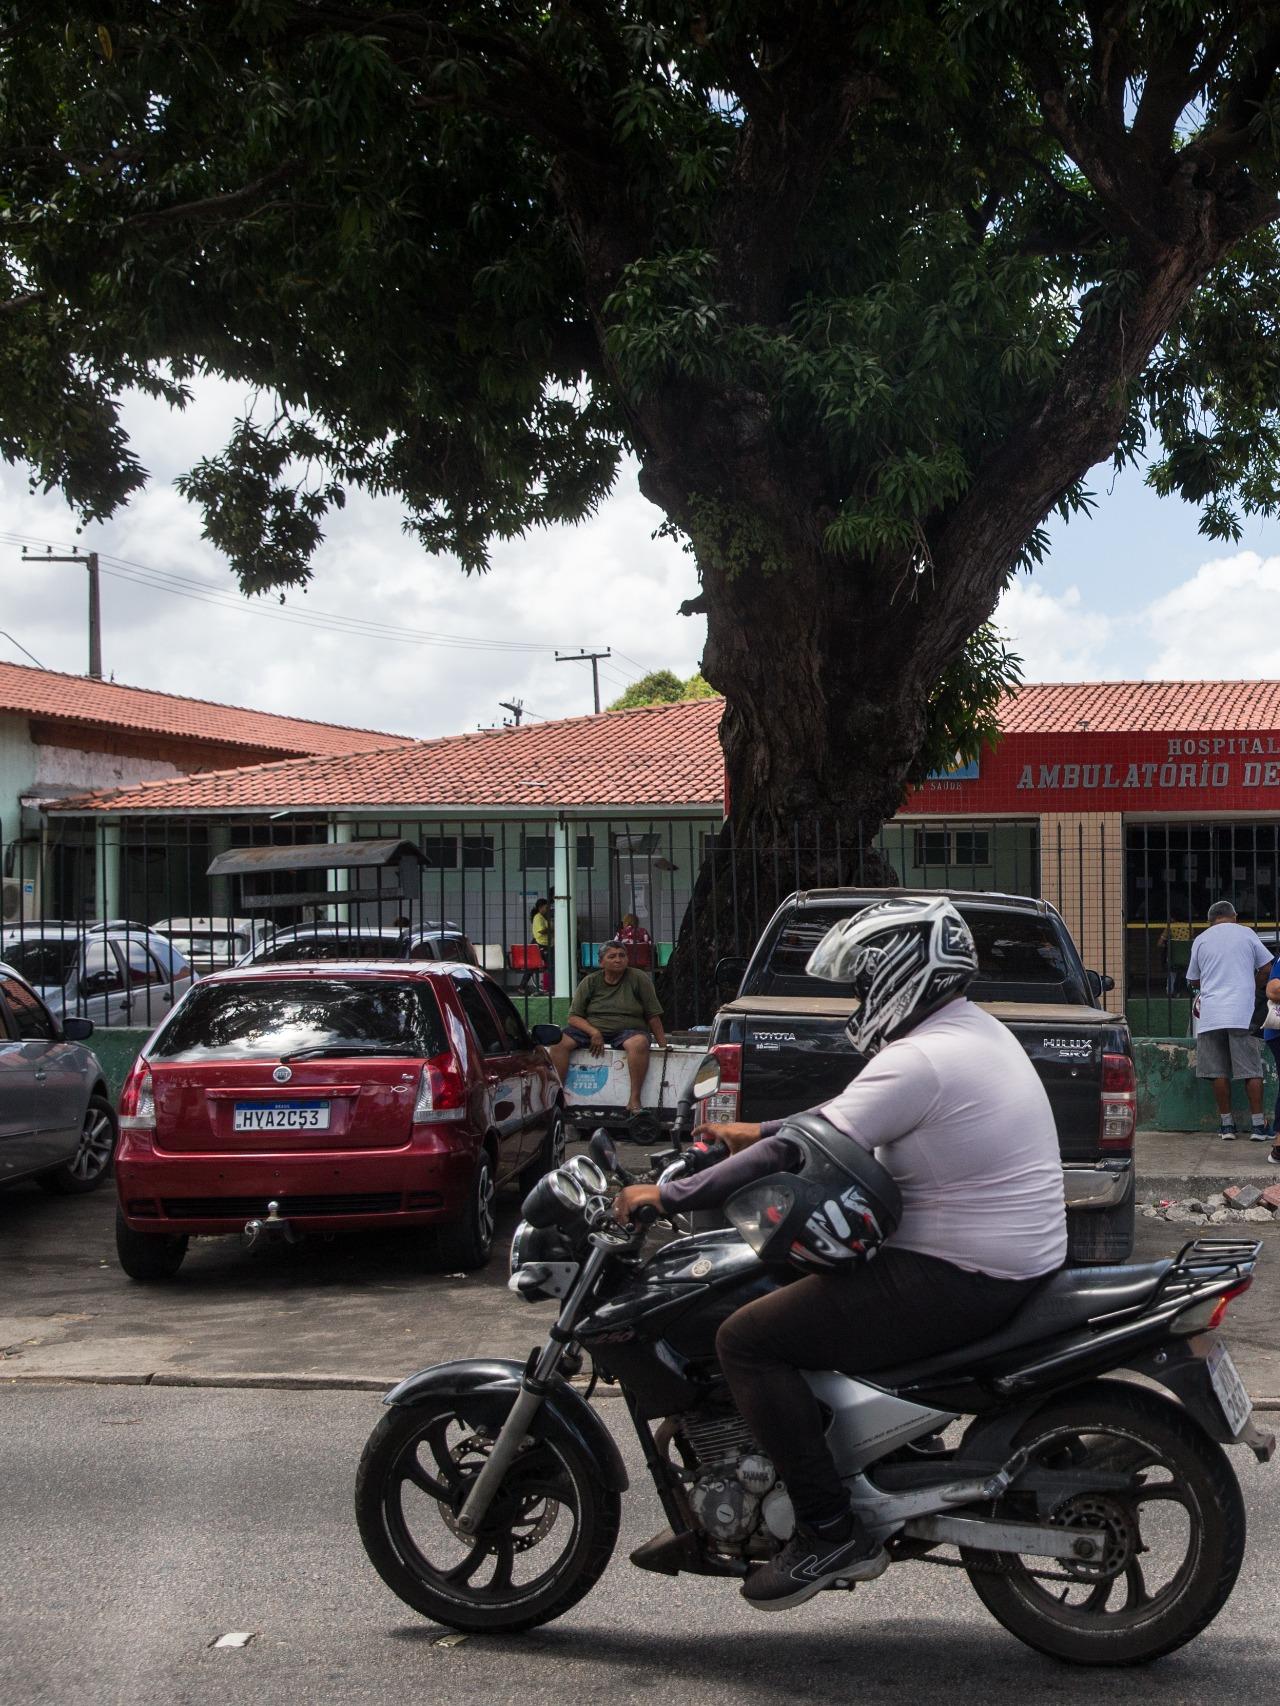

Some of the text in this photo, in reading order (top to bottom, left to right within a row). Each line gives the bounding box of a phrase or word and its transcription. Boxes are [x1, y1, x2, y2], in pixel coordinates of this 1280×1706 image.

[1167, 737, 1280, 756] HOSPITAL
[1016, 757, 1230, 789] AMBULATÓRIO
[752, 1031, 796, 1041] TOYOTA
[1043, 1038, 1093, 1048] HILUX
[1058, 1049, 1093, 1058] SRV
[243, 1110, 319, 1128] HYA2C53
